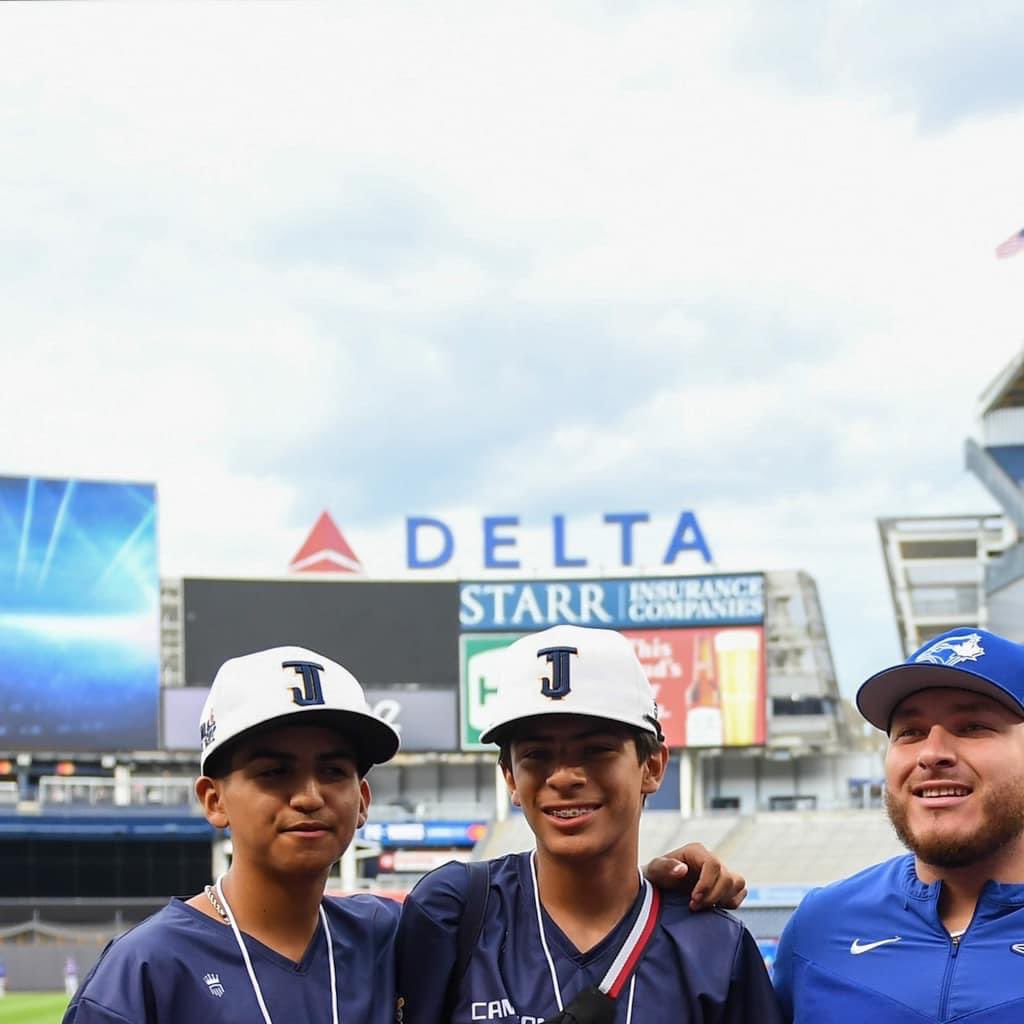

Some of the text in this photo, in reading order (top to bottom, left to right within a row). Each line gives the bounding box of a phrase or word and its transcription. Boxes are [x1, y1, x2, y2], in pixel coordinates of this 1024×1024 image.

[406, 510, 713, 570] DELTA
[459, 583, 614, 625] STARR
[629, 575, 763, 600] INSURANCE
[628, 597, 763, 622] COMPANIES
